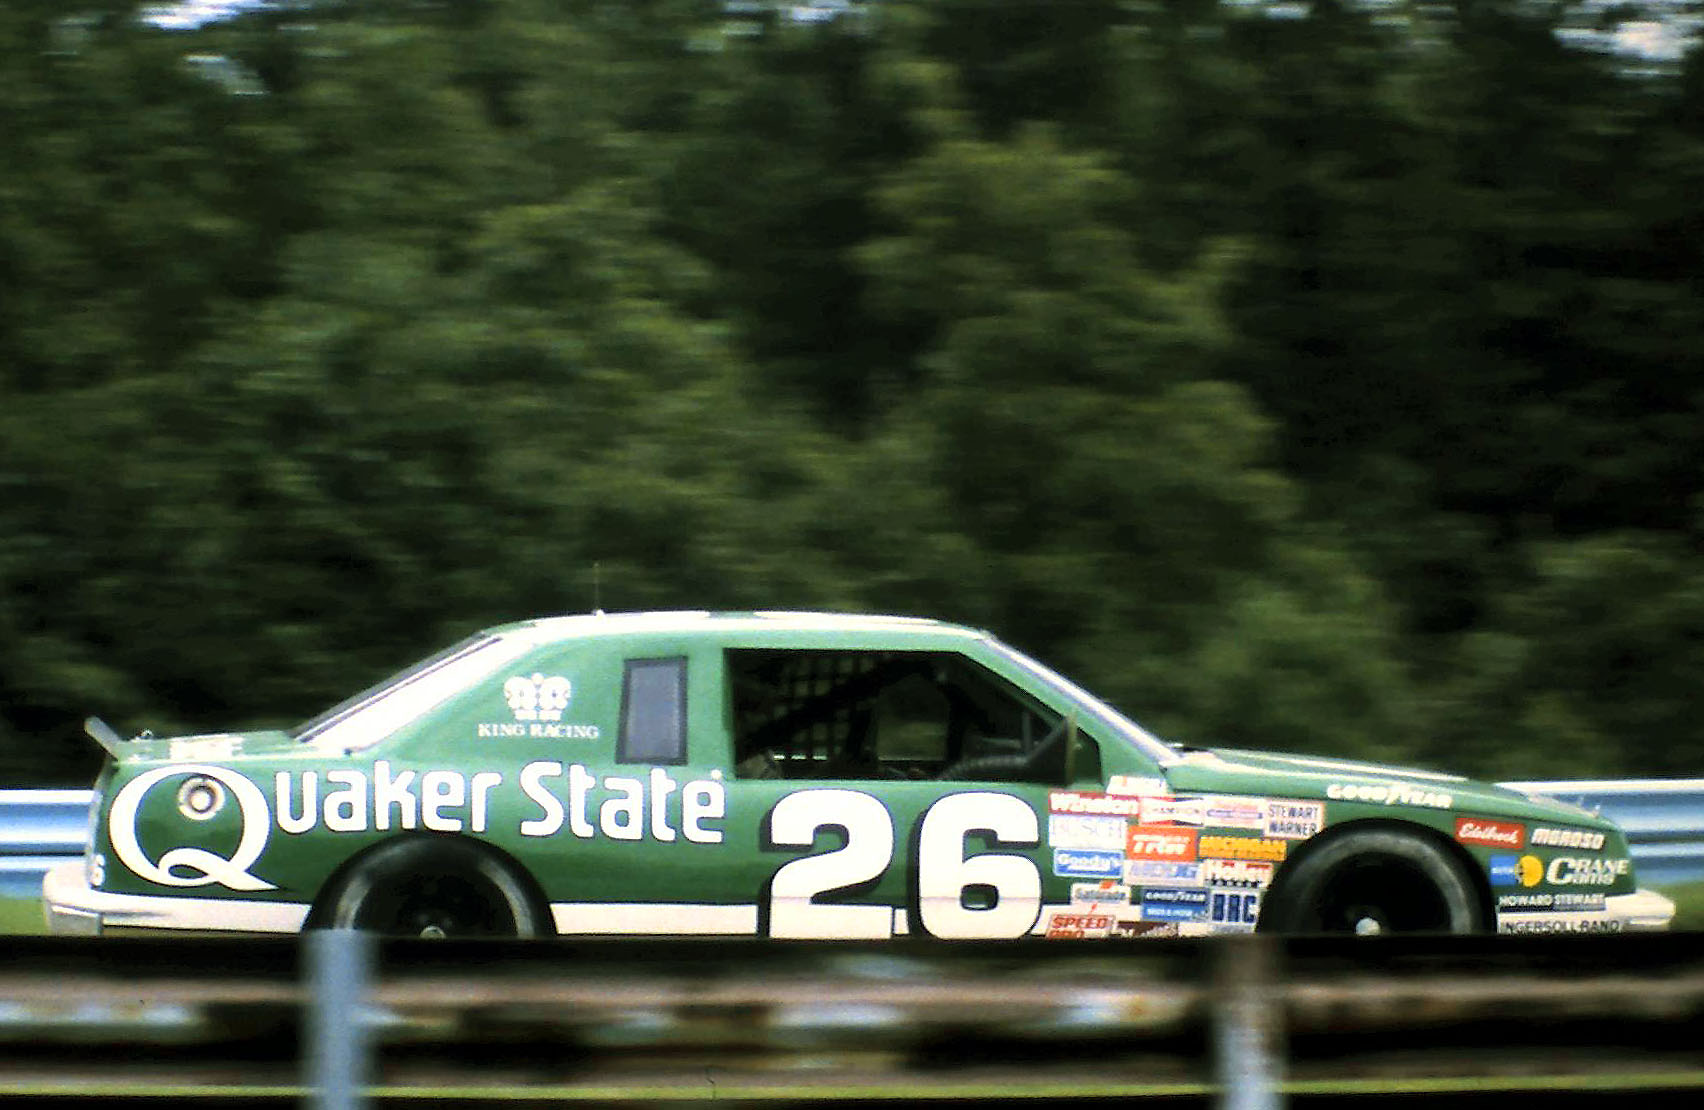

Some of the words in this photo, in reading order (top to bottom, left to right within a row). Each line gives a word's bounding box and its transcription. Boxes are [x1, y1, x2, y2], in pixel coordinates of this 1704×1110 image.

[478, 723, 526, 737] KING
[530, 724, 599, 739] RACING
[1049, 792, 1139, 814] Winston
[1268, 804, 1319, 818] STEWART
[109, 760, 502, 892] Quaker
[520, 761, 725, 844] State
[1269, 821, 1318, 837] WARNER
[1132, 835, 1190, 855] TRW
[765, 788, 1042, 940] 26
[1546, 857, 1630, 886] CRANE
[1499, 894, 1553, 906] HOWARD
[1051, 916, 1109, 929] SPEED
